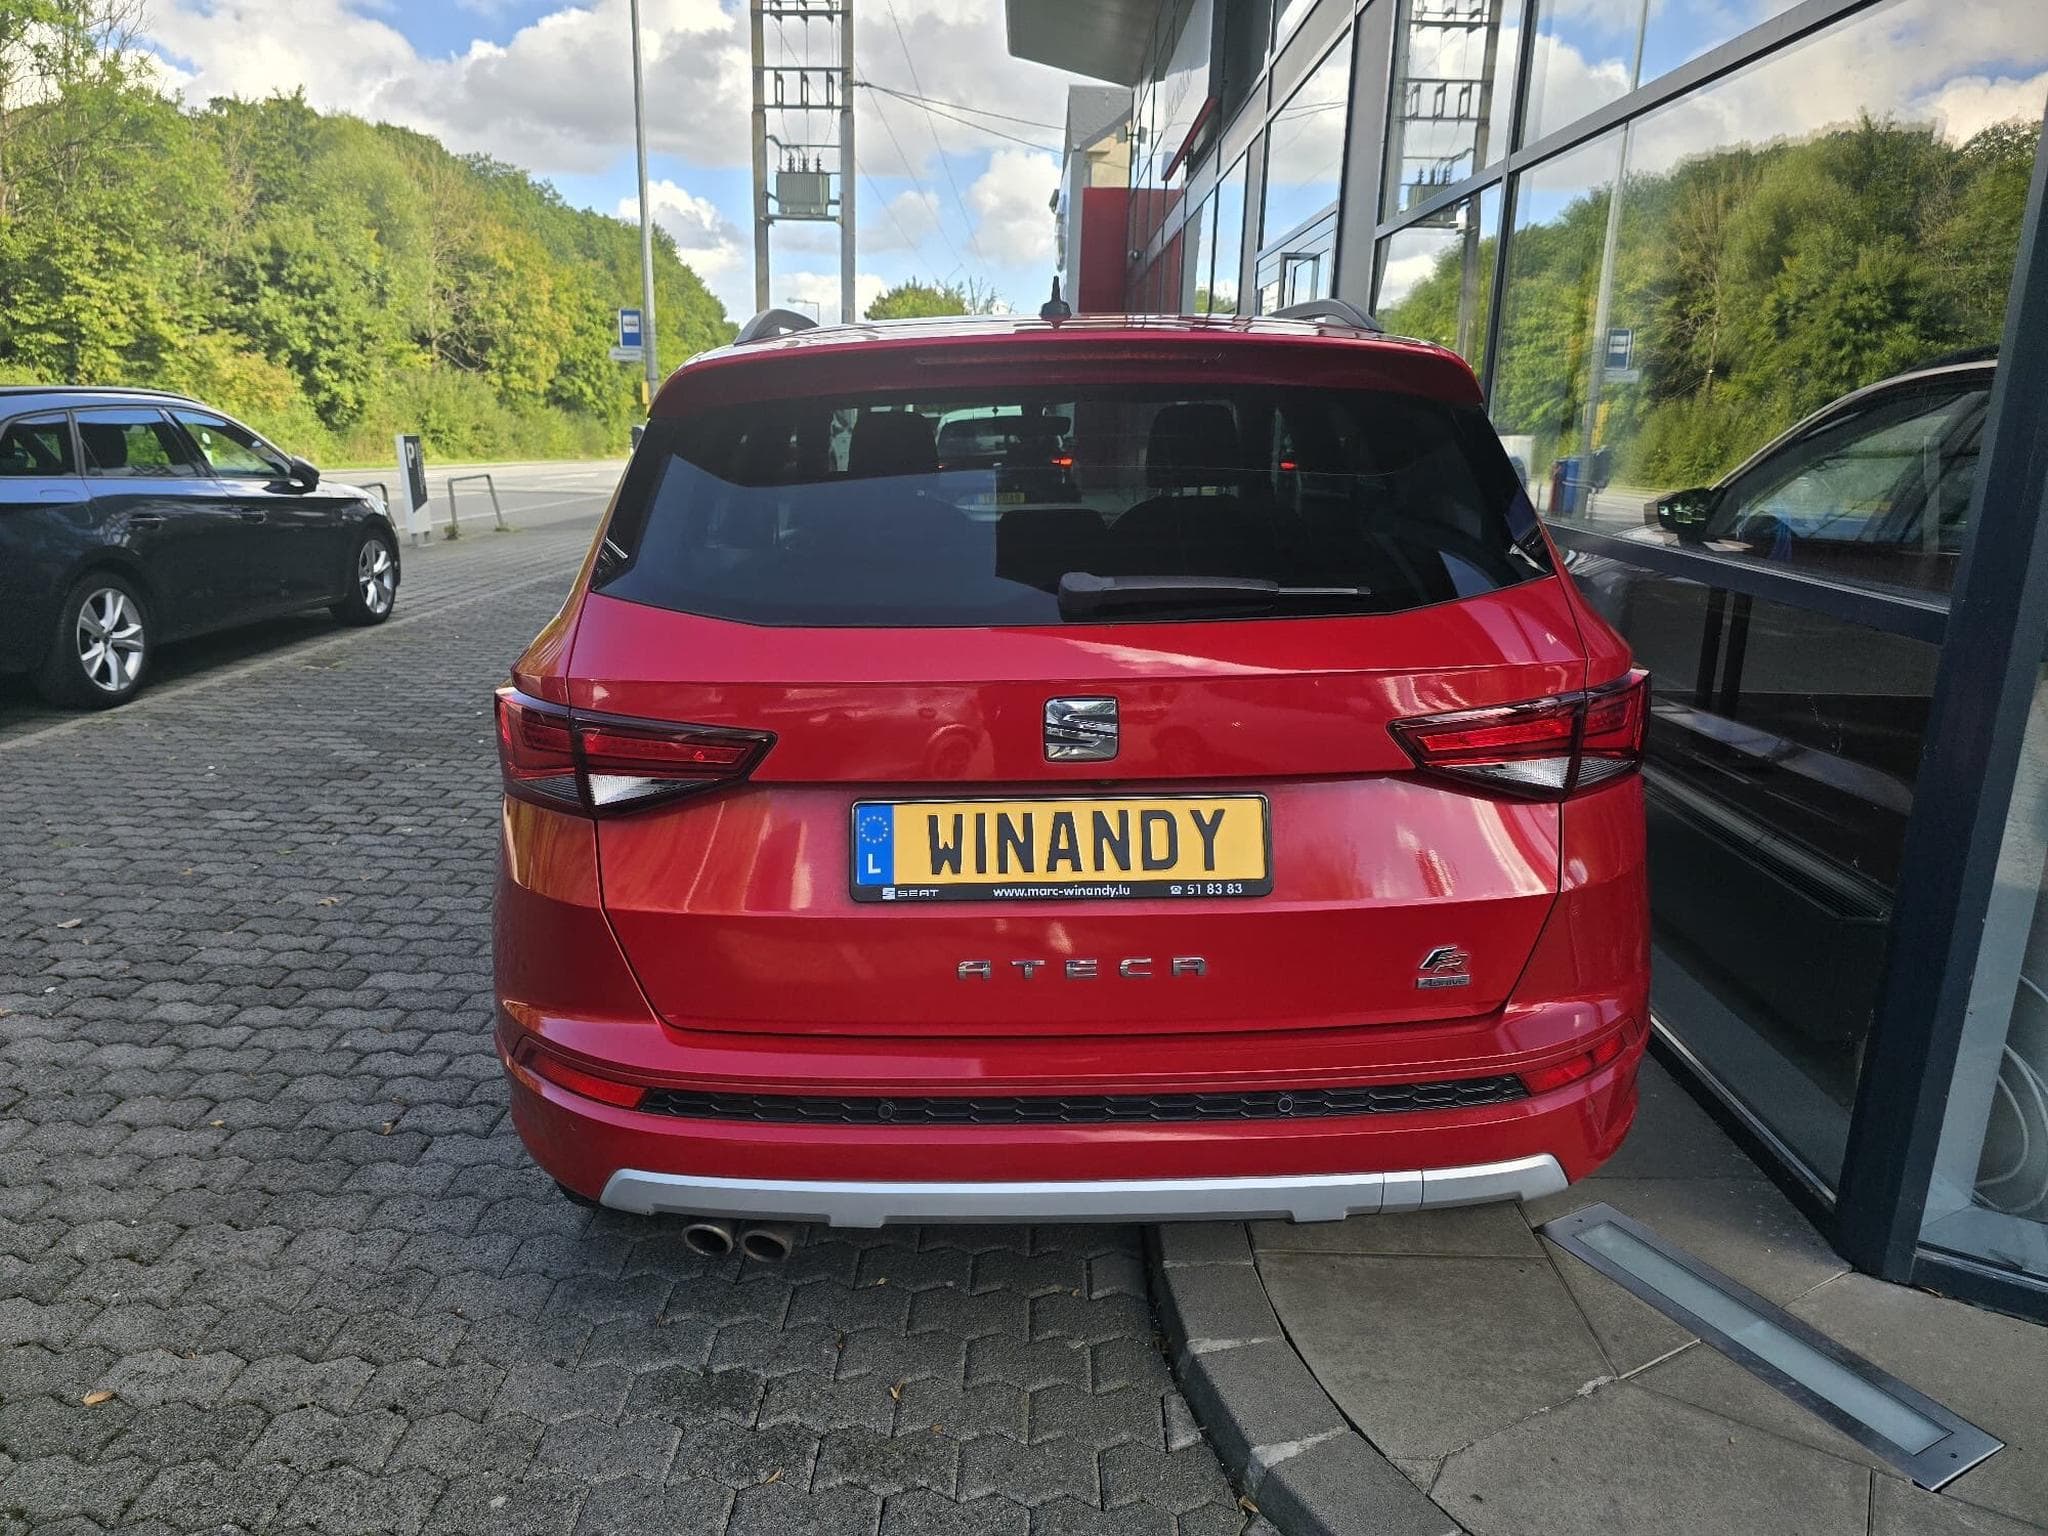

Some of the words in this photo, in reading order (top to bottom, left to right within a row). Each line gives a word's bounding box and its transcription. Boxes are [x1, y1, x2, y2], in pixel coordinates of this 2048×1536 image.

[406, 442, 415, 468] P
[928, 808, 1226, 876] WINANDY
[867, 853, 882, 875] L
[897, 888, 940, 898] SEAT
[992, 884, 1131, 898] www.marc-winandy.lu
[1187, 884, 1201, 895] 51
[1206, 883, 1223, 895] 83
[1226, 882, 1243, 894] 83
[957, 956, 1207, 980] ATECA
